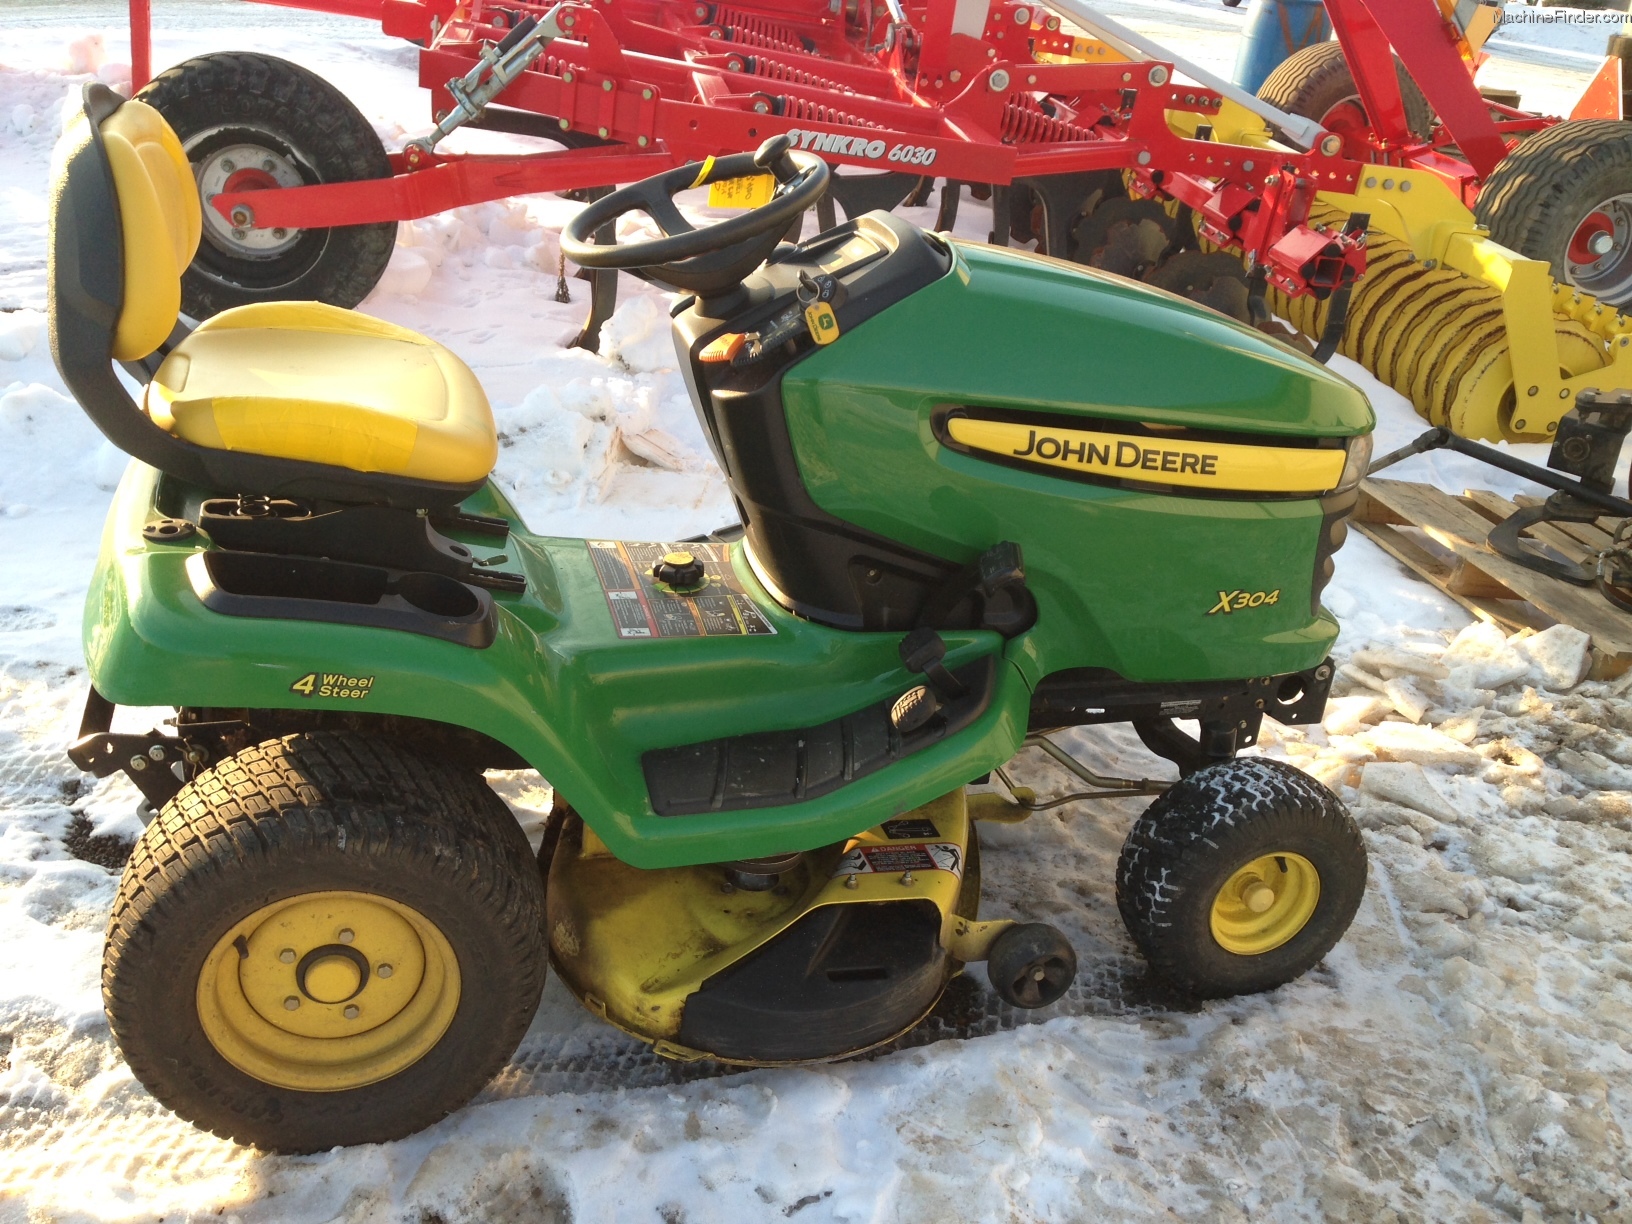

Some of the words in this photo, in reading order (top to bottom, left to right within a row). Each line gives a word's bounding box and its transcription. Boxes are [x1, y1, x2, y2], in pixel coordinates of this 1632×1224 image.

[786, 128, 886, 160] SYNKRO
[887, 143, 938, 167] 6030
[1013, 430, 1111, 466] JOHN
[1114, 440, 1219, 476] DEERE
[1207, 589, 1280, 614] X304
[292, 674, 316, 695] 4
[323, 673, 374, 688] Wheel
[318, 685, 369, 699] Steer
